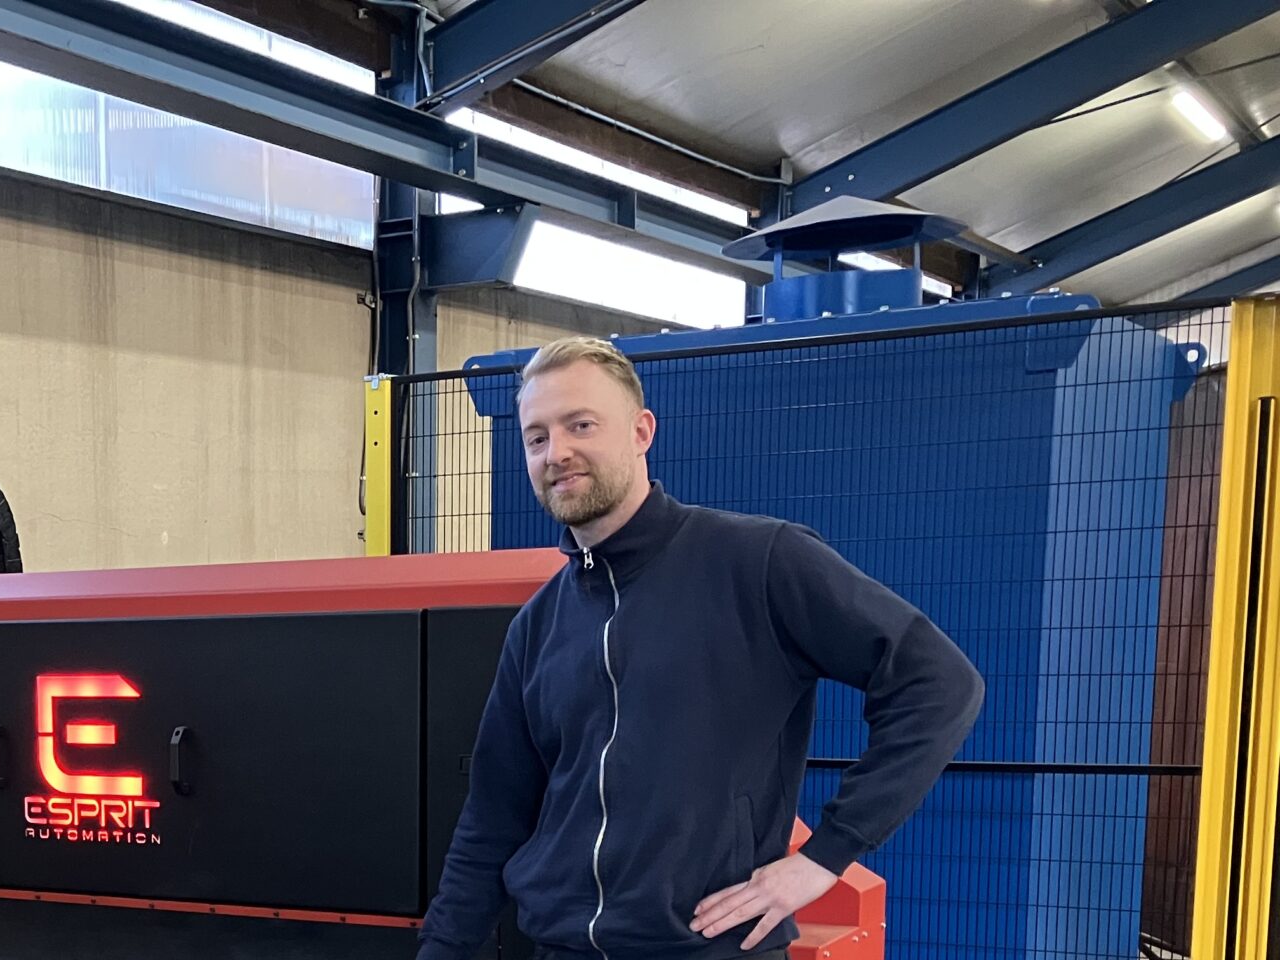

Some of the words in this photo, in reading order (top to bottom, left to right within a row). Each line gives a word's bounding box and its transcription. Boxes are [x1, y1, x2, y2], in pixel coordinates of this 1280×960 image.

[35, 674, 143, 797] E
[24, 797, 161, 828] ESPRIT
[24, 828, 161, 845] AUTOMATION
